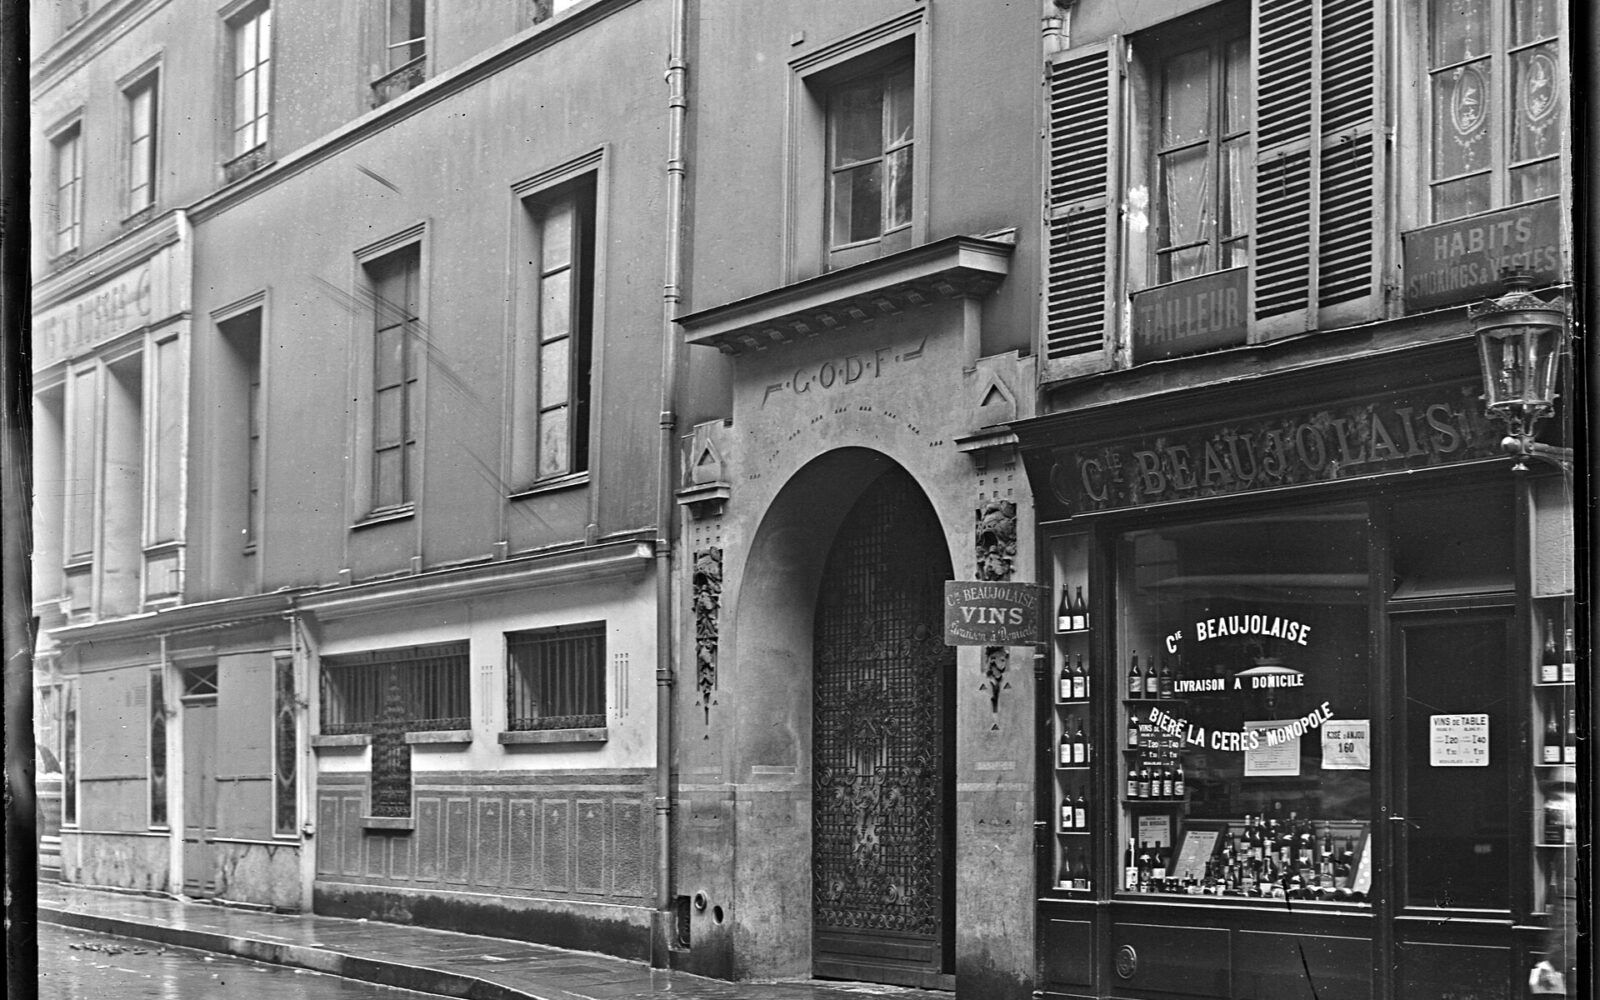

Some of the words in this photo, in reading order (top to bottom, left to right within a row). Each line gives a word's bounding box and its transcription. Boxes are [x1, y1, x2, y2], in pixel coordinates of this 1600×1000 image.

[1434, 216, 1533, 261] HABITS
[1410, 262, 1479, 299] SMOKINGS
[1480, 267, 1489, 285] &
[1140, 287, 1240, 345] TAILLEUR
[963, 586, 1038, 609] BEAUJOLAISE
[959, 606, 1023, 625] VINS
[1196, 615, 1311, 646] BEAUJOLAISE
[1174, 678, 1225, 692] LIVRAISON
[1234, 678, 1242, 690] A
[1252, 674, 1304, 689] DOMICILE
[1266, 701, 1334, 747] MONOPOLE
[1433, 717, 1451, 726] VINS
[1461, 716, 1486, 726] TABLE
